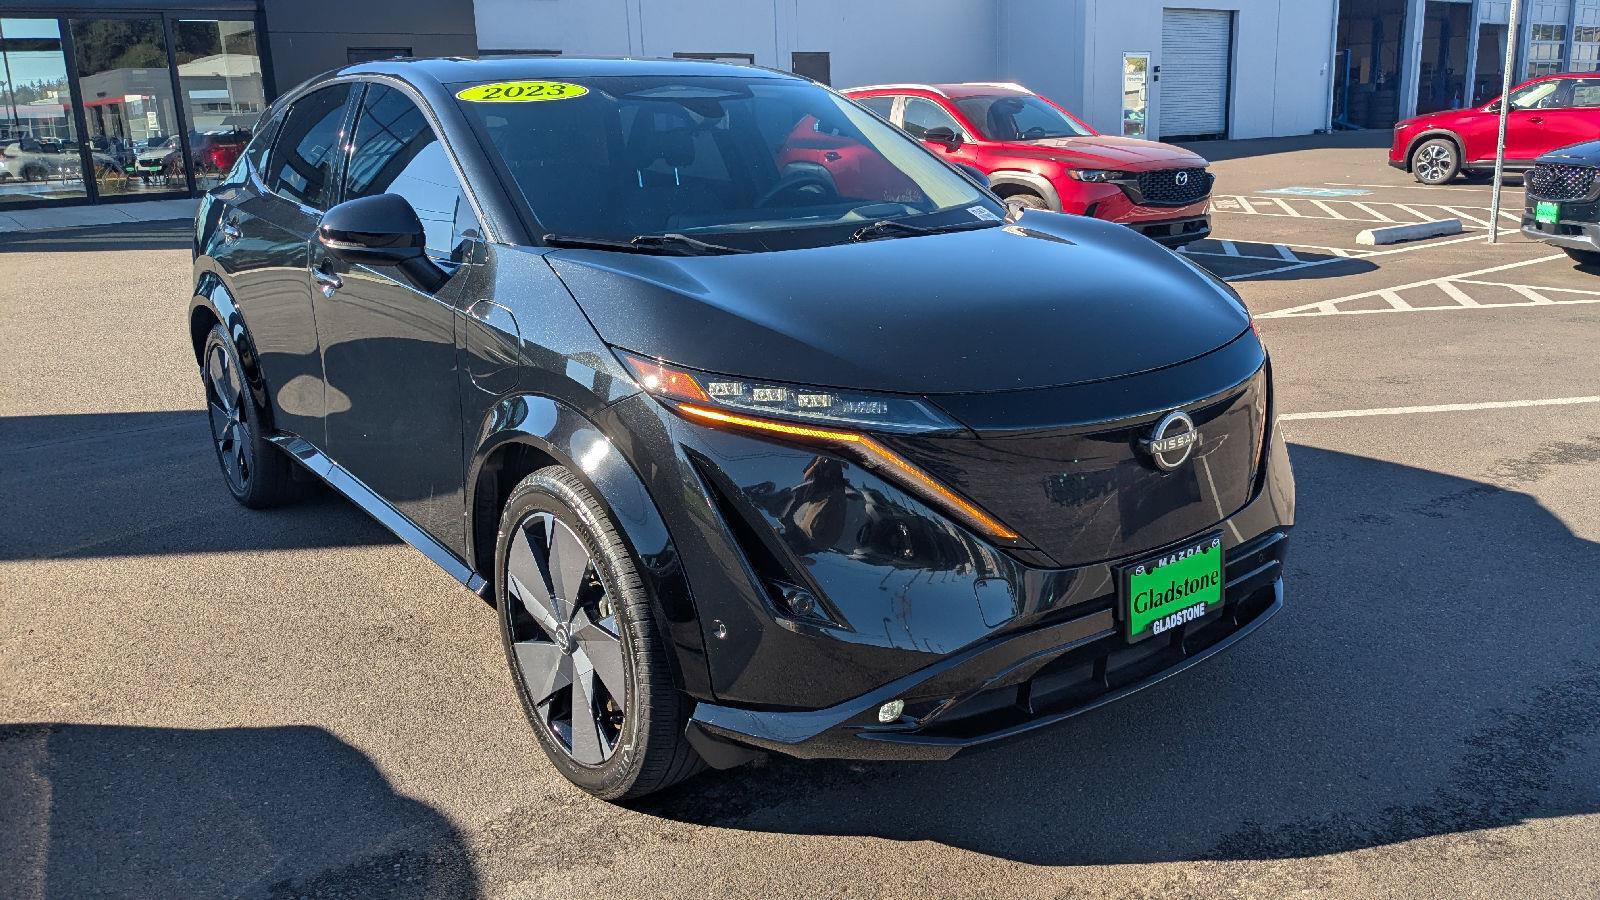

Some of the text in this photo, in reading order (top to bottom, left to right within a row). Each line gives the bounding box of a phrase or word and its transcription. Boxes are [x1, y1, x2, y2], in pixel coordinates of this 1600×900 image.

[482, 85, 566, 100] 2023
[1152, 431, 1198, 452] NISSAN
[1158, 545, 1202, 568] MAZDA
[1134, 569, 1219, 614] Gladstone
[1153, 602, 1205, 635] GLADSTONE
